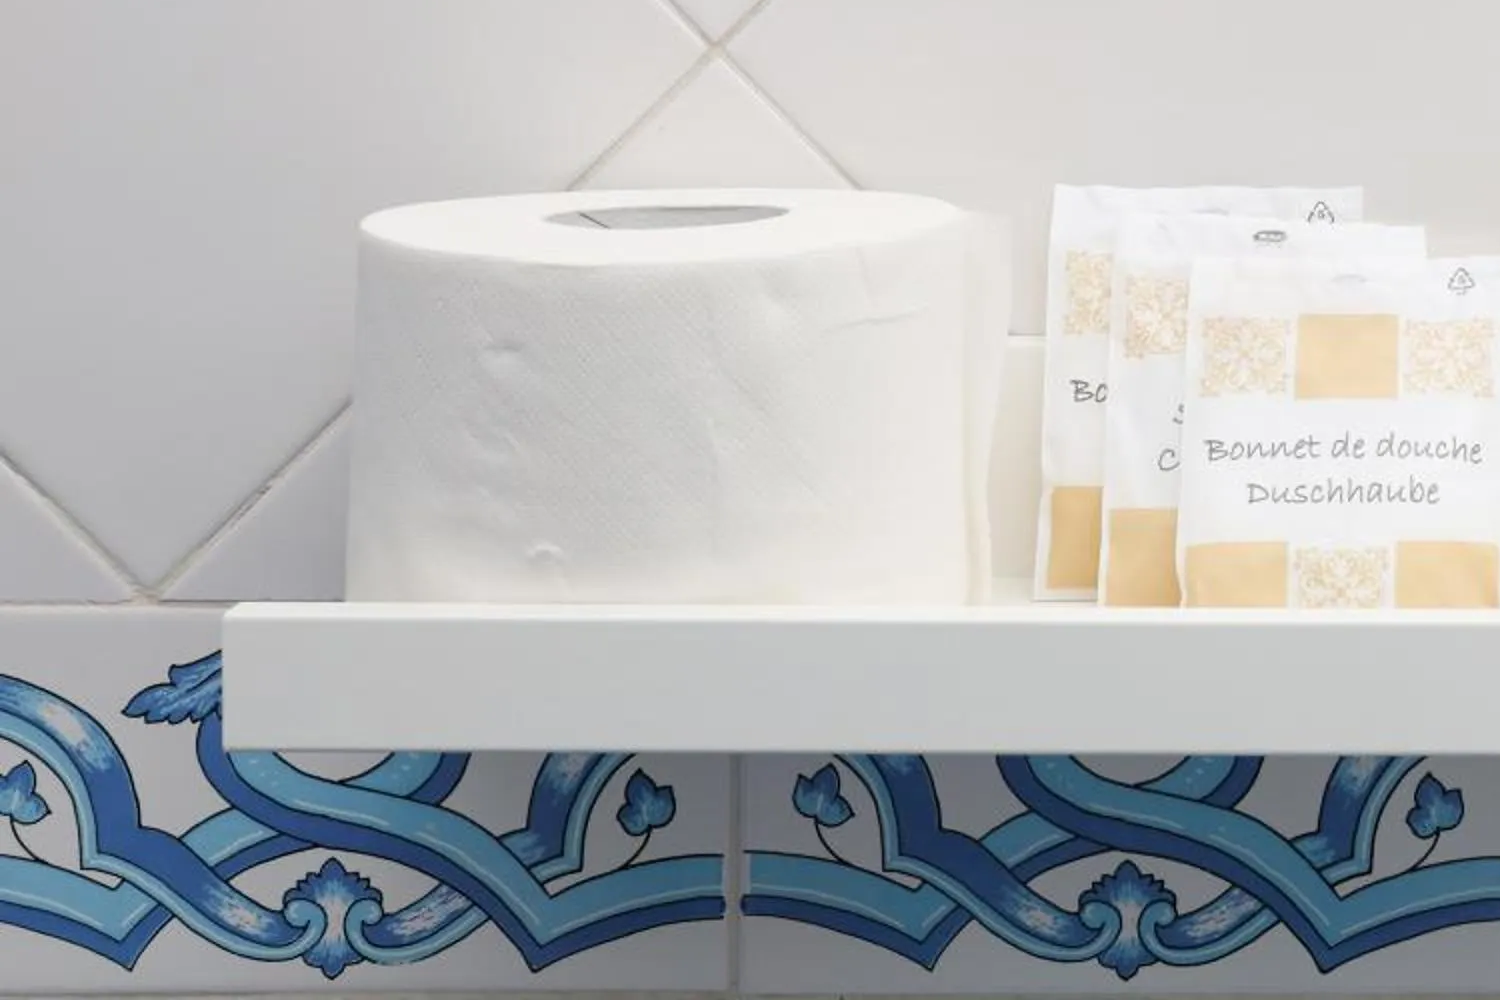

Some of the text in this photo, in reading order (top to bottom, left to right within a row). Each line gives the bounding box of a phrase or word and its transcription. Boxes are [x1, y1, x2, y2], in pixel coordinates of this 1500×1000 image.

[1204, 435, 1320, 463] Bonnet
[1331, 431, 1365, 459] de
[1375, 433, 1483, 464] douche
[1247, 475, 1440, 504] Duschhaube
